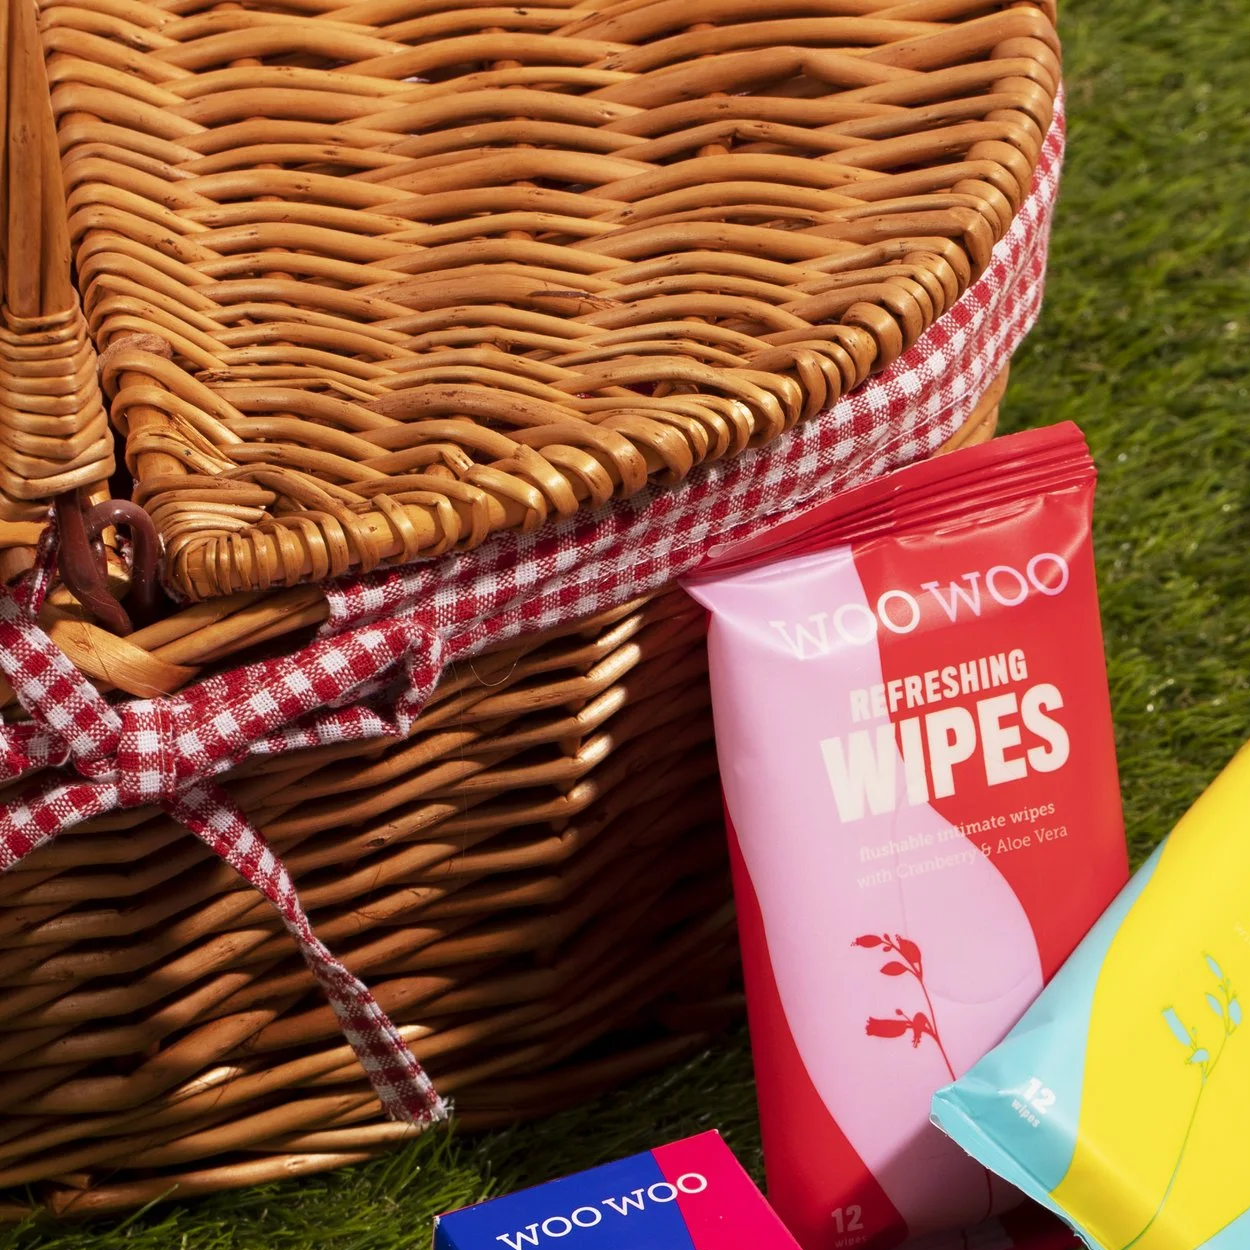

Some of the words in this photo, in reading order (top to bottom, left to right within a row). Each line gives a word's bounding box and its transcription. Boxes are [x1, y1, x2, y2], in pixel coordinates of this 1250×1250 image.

[770, 590, 920, 660] WOO
[921, 553, 1069, 622] WOO
[850, 649, 1028, 722] REFRESHING
[819, 683, 1070, 824] WIPES
[856, 863, 894, 890] with
[896, 845, 978, 882] Cranberry
[981, 843, 992, 858] &
[996, 834, 1032, 854] Aloe
[1034, 824, 1068, 843] Vera
[859, 831, 934, 864] flushable
[936, 813, 1006, 842] intimate
[1009, 803, 1056, 833] wipes
[1010, 1098, 1040, 1128] wipes
[1022, 1077, 1057, 1114] 12
[602, 1172, 708, 1217] WOO
[831, 1204, 864, 1234] 12
[834, 1235, 868, 1248] wipes
